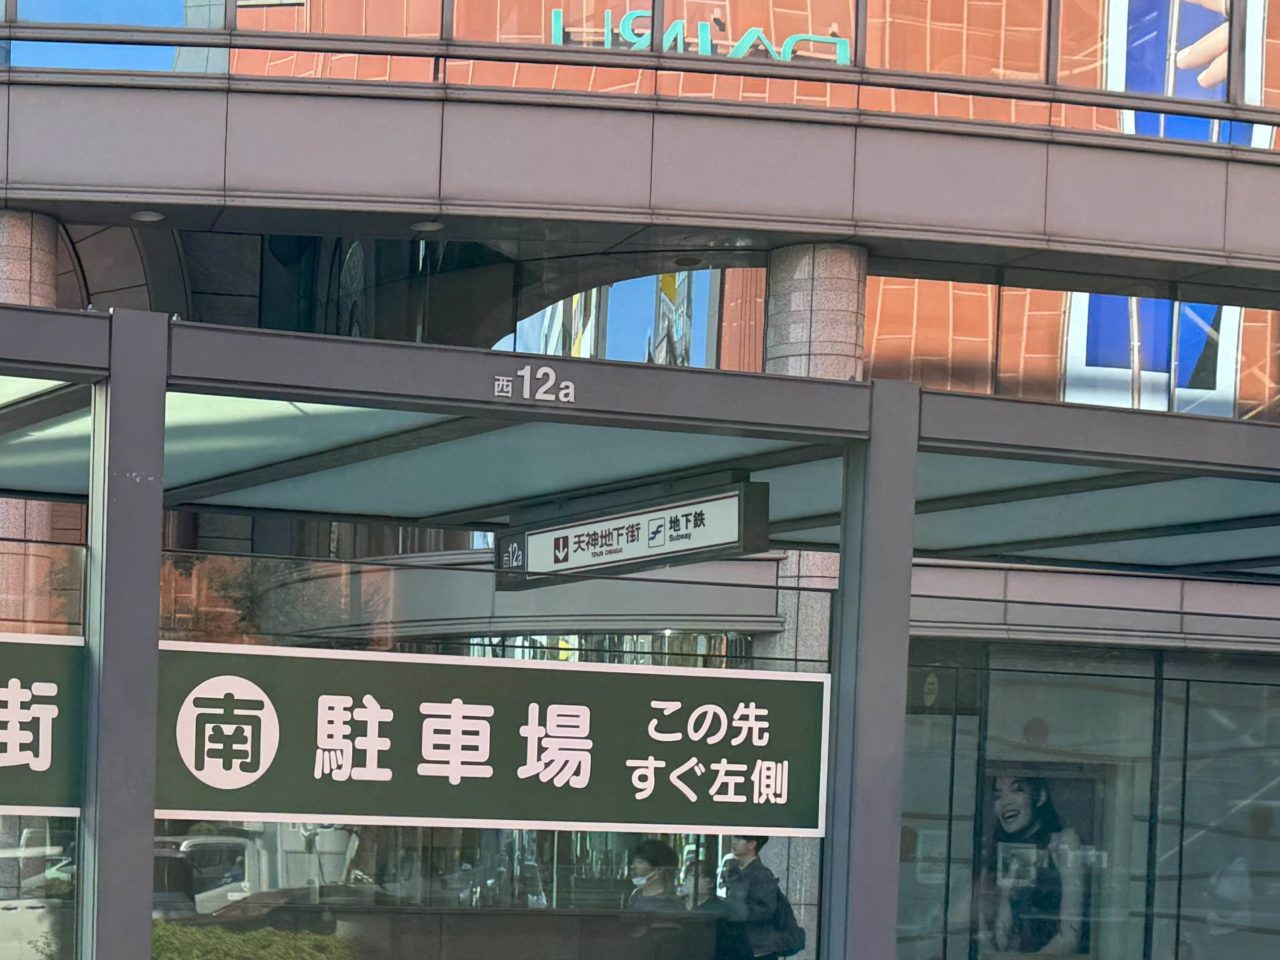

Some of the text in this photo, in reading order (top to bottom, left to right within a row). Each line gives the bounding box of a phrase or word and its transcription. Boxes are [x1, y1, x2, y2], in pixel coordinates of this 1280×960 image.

[572, 509, 706, 553] 天神地下街 地下鉄
[313, 694, 595, 789] 駐車場
[647, 699, 771, 748] この先
[625, 755, 789, 805] すぐ左側
